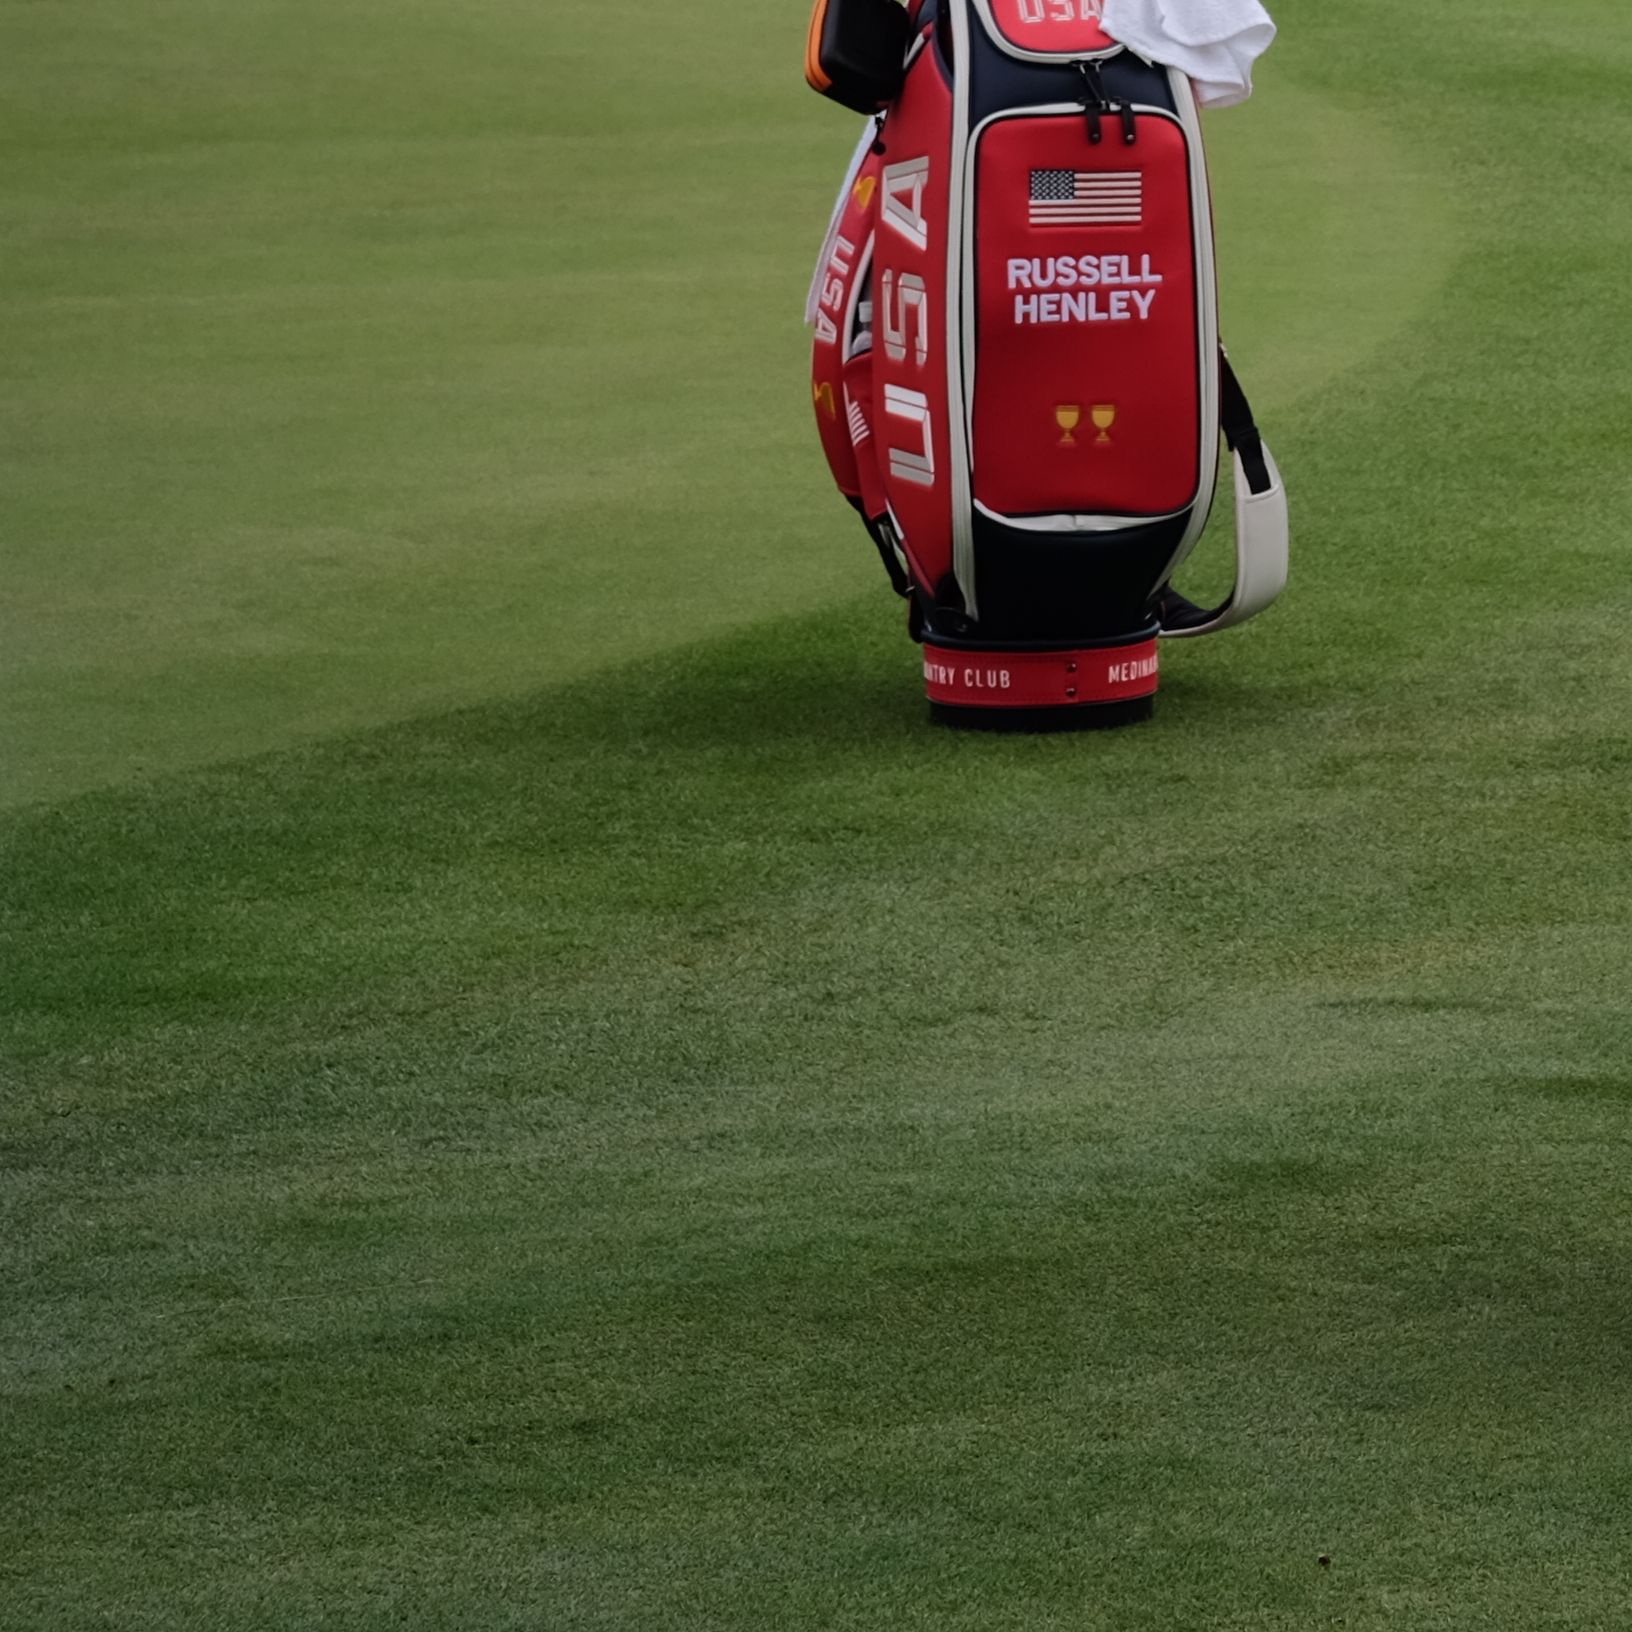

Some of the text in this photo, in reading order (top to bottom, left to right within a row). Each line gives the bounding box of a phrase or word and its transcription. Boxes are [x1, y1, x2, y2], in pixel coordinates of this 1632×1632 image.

[1007, 254, 1163, 290] RUSSELL
[881, 155, 935, 487] USA
[1014, 289, 1157, 325] HENLEY
[964, 668, 1011, 688] CLUB
